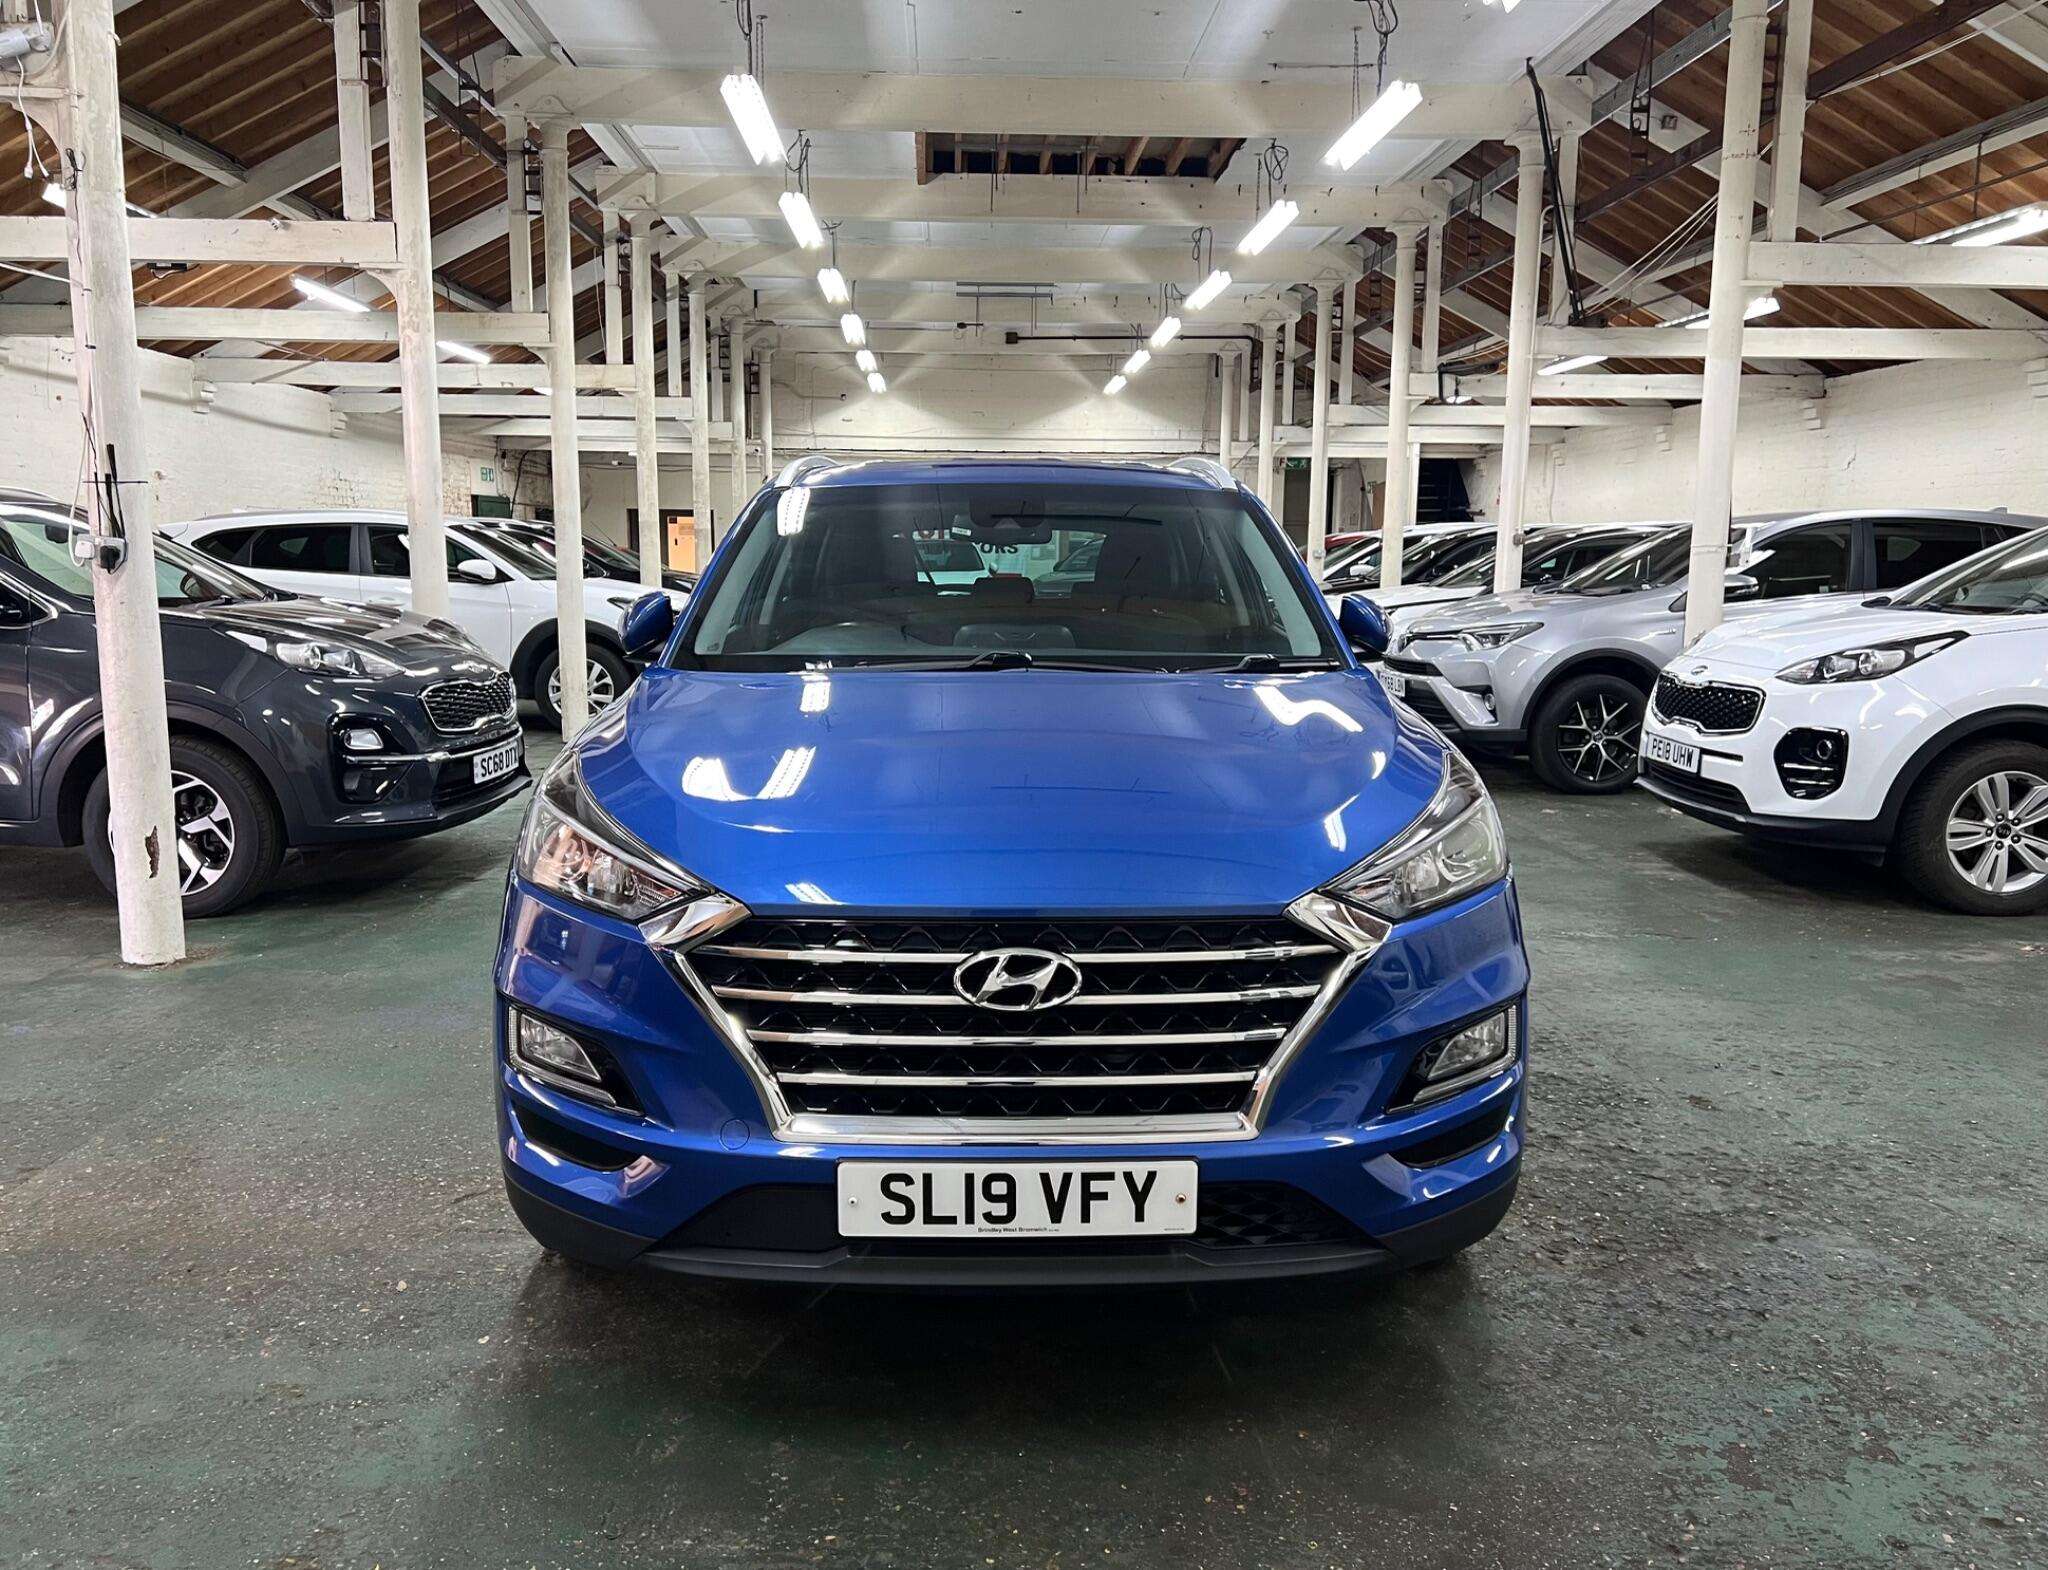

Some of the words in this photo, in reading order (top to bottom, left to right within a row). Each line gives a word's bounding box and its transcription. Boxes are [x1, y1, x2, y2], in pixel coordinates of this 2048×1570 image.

[481, 751, 504, 778] SC68
[1651, 738, 1671, 761] PE18
[1672, 743, 1694, 768] UHW
[880, 1172, 1017, 1226] SL19
[1039, 1170, 1157, 1225] VFY
